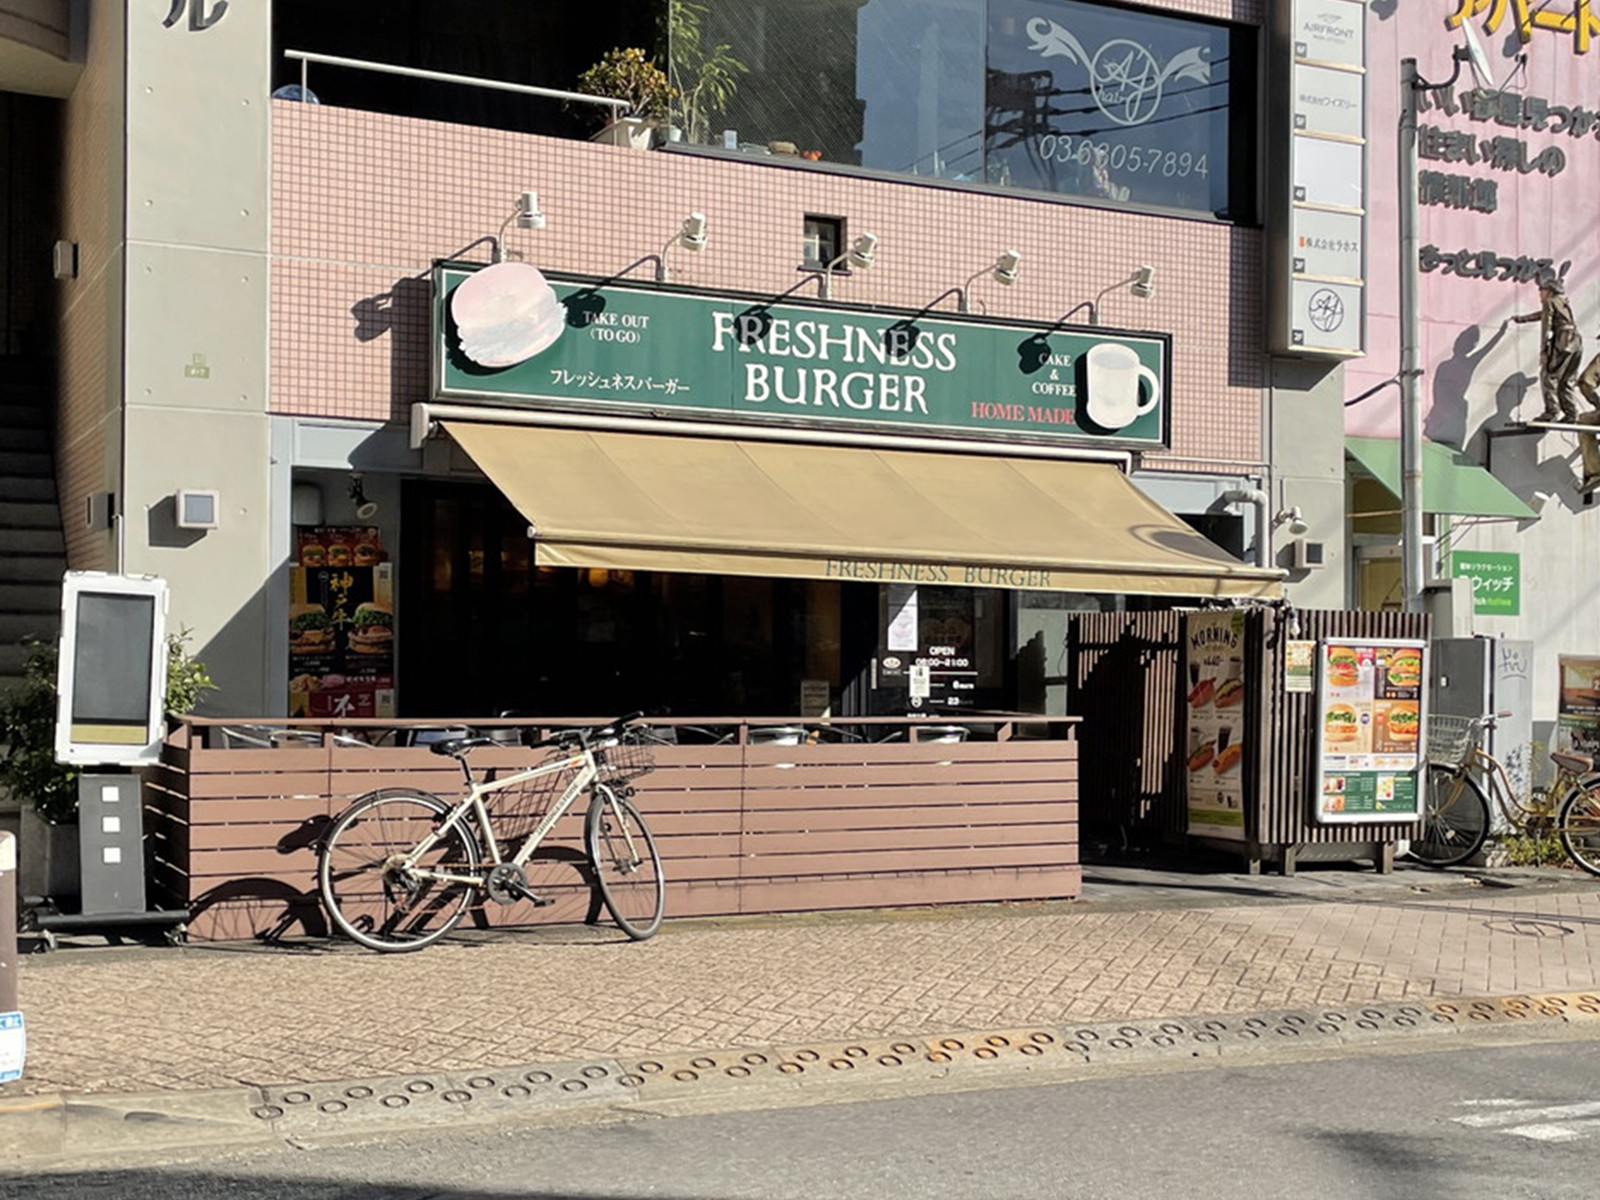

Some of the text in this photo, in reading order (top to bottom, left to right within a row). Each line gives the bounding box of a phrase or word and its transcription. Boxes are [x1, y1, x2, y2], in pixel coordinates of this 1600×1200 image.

[583, 311, 650, 329] TAKE OUT
[712, 311, 957, 371] FRESHNESS
[1039, 353, 1071, 367] CAKE
[550, 369, 690, 395] フレッシュネスバーガー
[1049, 369, 1060, 381] &
[744, 363, 929, 414] BURGER
[1031, 381, 1076, 397] COFFEE
[971, 401, 1076, 425] HOME MADE
[825, 559, 1052, 587] FRESHNESS BURGER
[1459, 574, 1514, 592] ウィッチ
[1191, 627, 1238, 650] MORNING
[929, 646, 956, 656] OPEN
